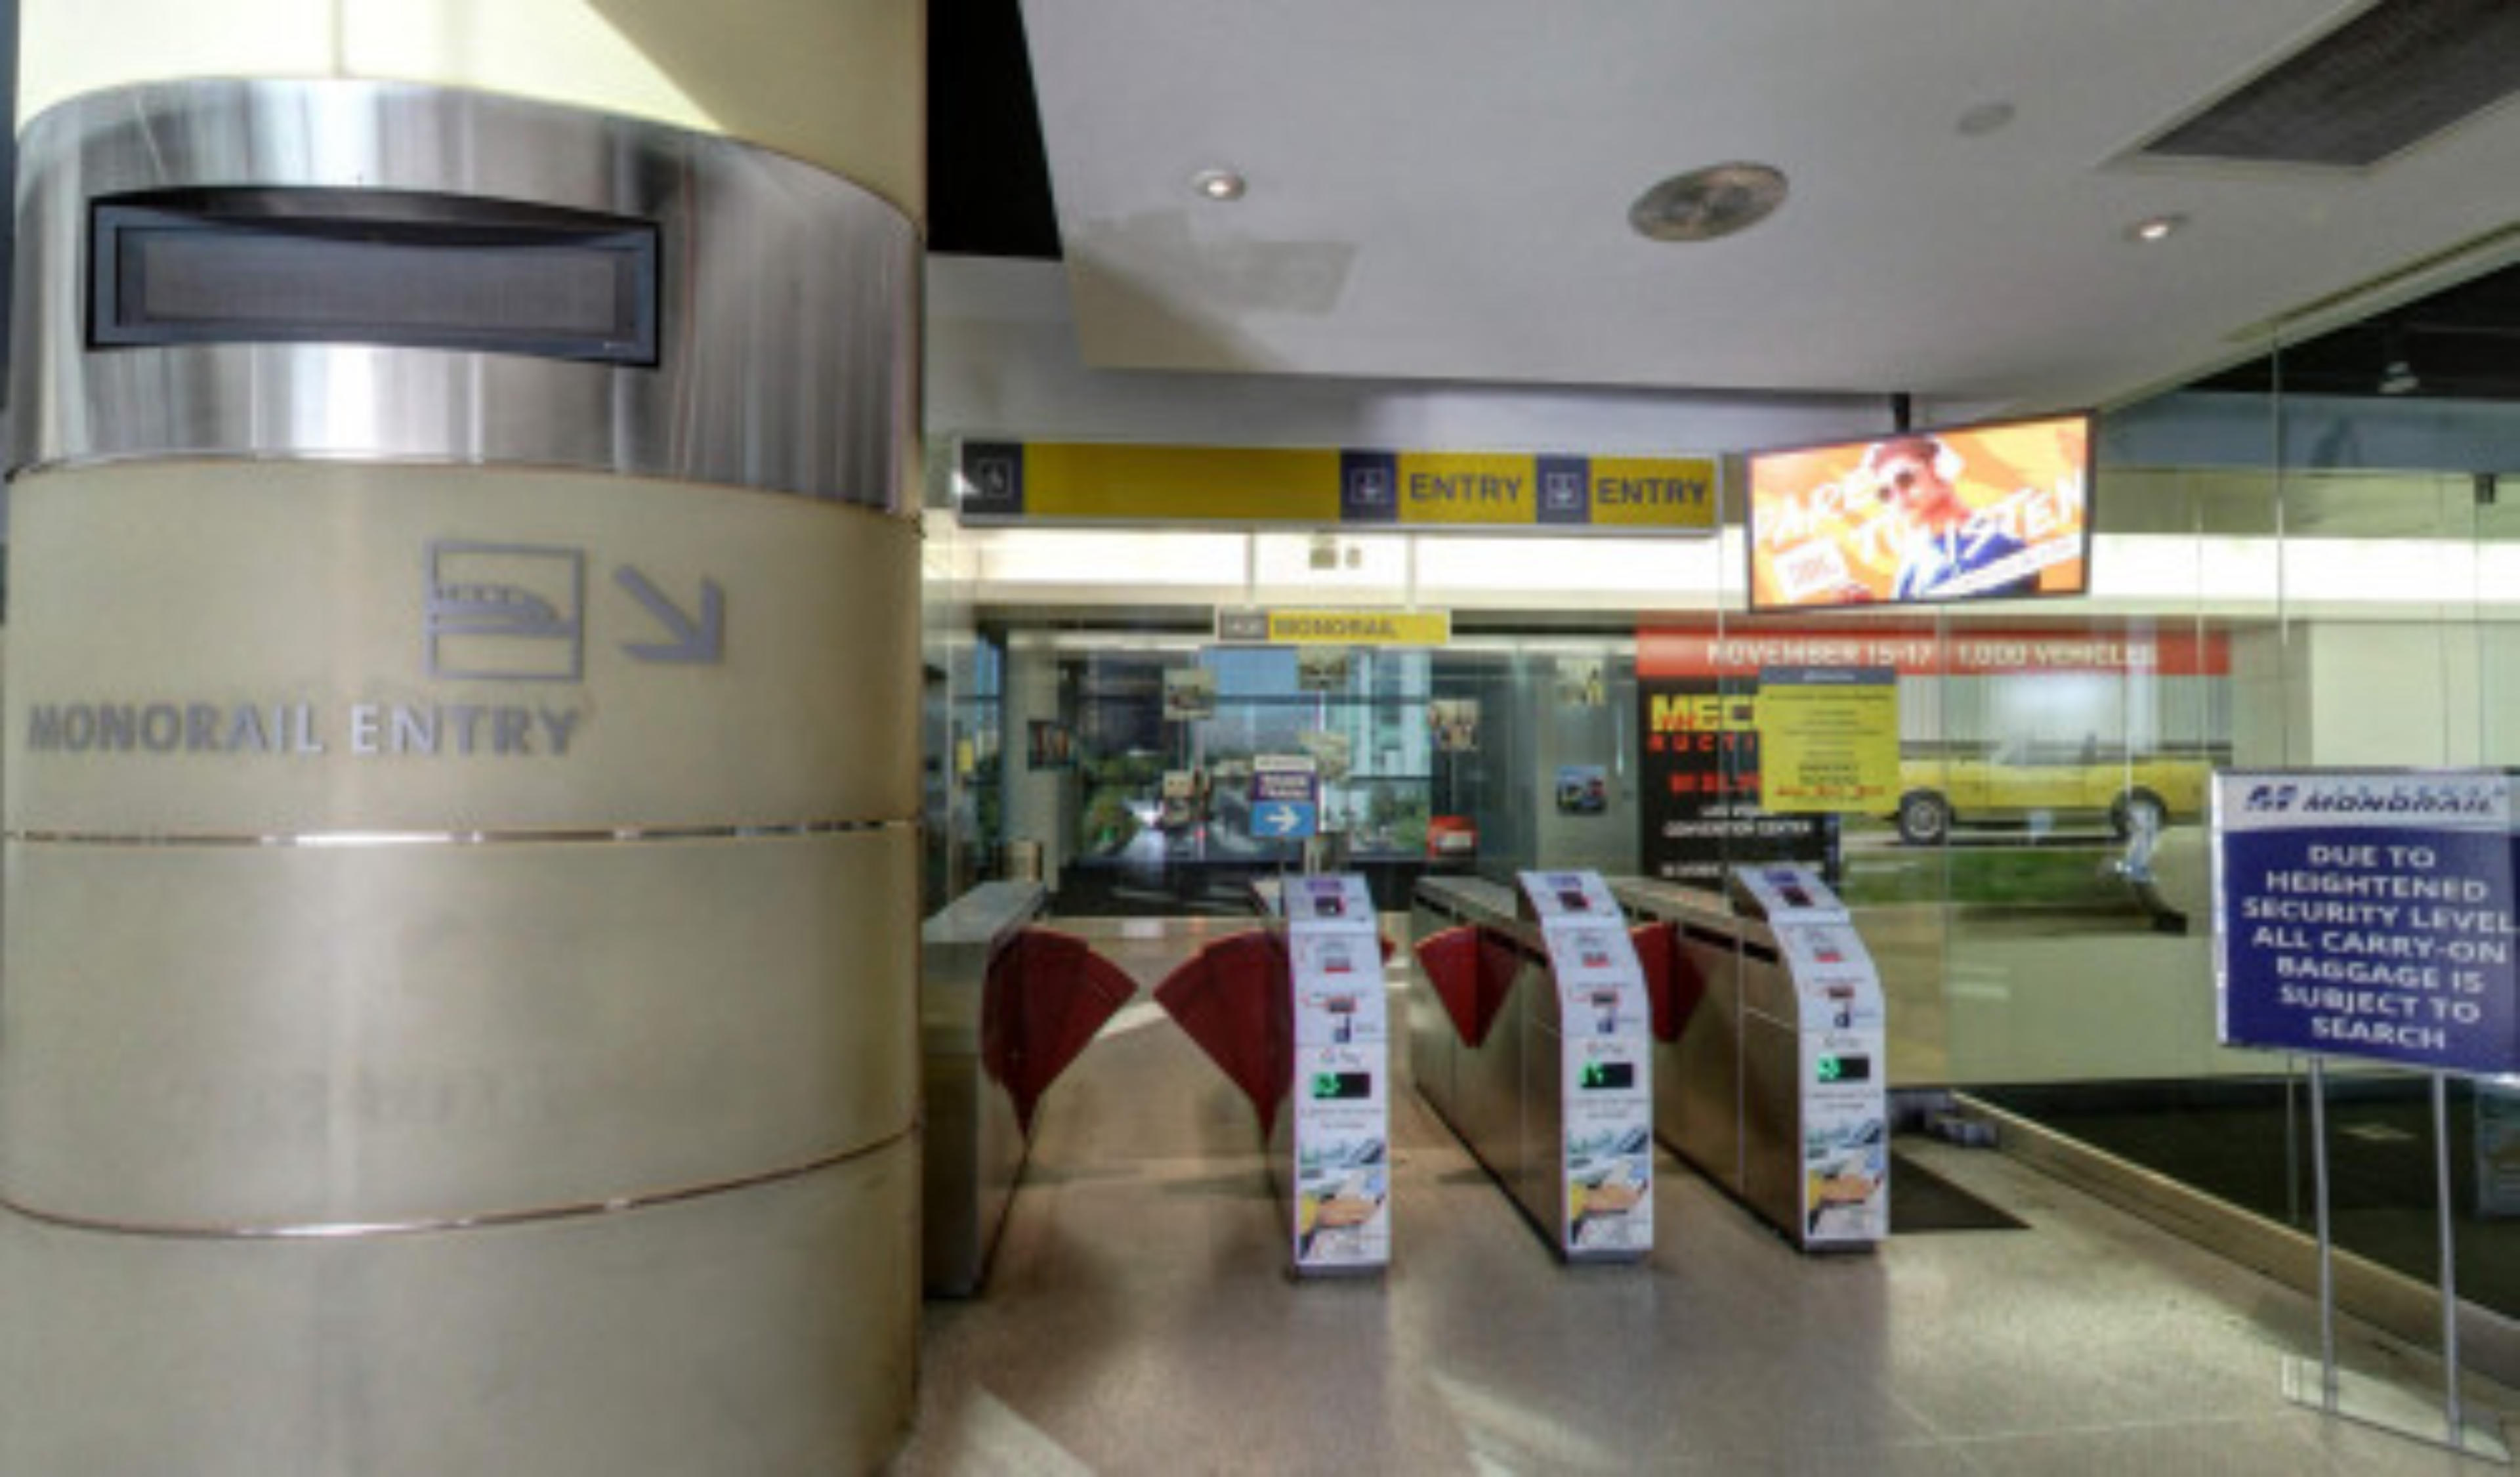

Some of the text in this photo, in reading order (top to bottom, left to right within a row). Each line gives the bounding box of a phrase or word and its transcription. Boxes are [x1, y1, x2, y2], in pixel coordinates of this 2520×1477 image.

[1410, 473, 1523, 502] ENTRY
[1597, 477, 1706, 505] ENTRY
[1708, 640, 1860, 666] NOVEMBER
[28, 701, 583, 757] MONORAIL ENTRY
[1650, 695, 1761, 733] MEC
[2302, 785, 2494, 813] MONORAIL
[2307, 845, 2436, 868] DUE TO
[2265, 870, 2489, 903] HEIGHTENED
[2242, 897, 2519, 934] SECURITY LEVEL
[2252, 926, 2507, 964] ALL CARRY-ON
[2276, 956, 2485, 995] BAGGAGE IS
[2280, 983, 2481, 1024] SUBJECT TO
[2311, 1016, 2447, 1050] SEARCH
